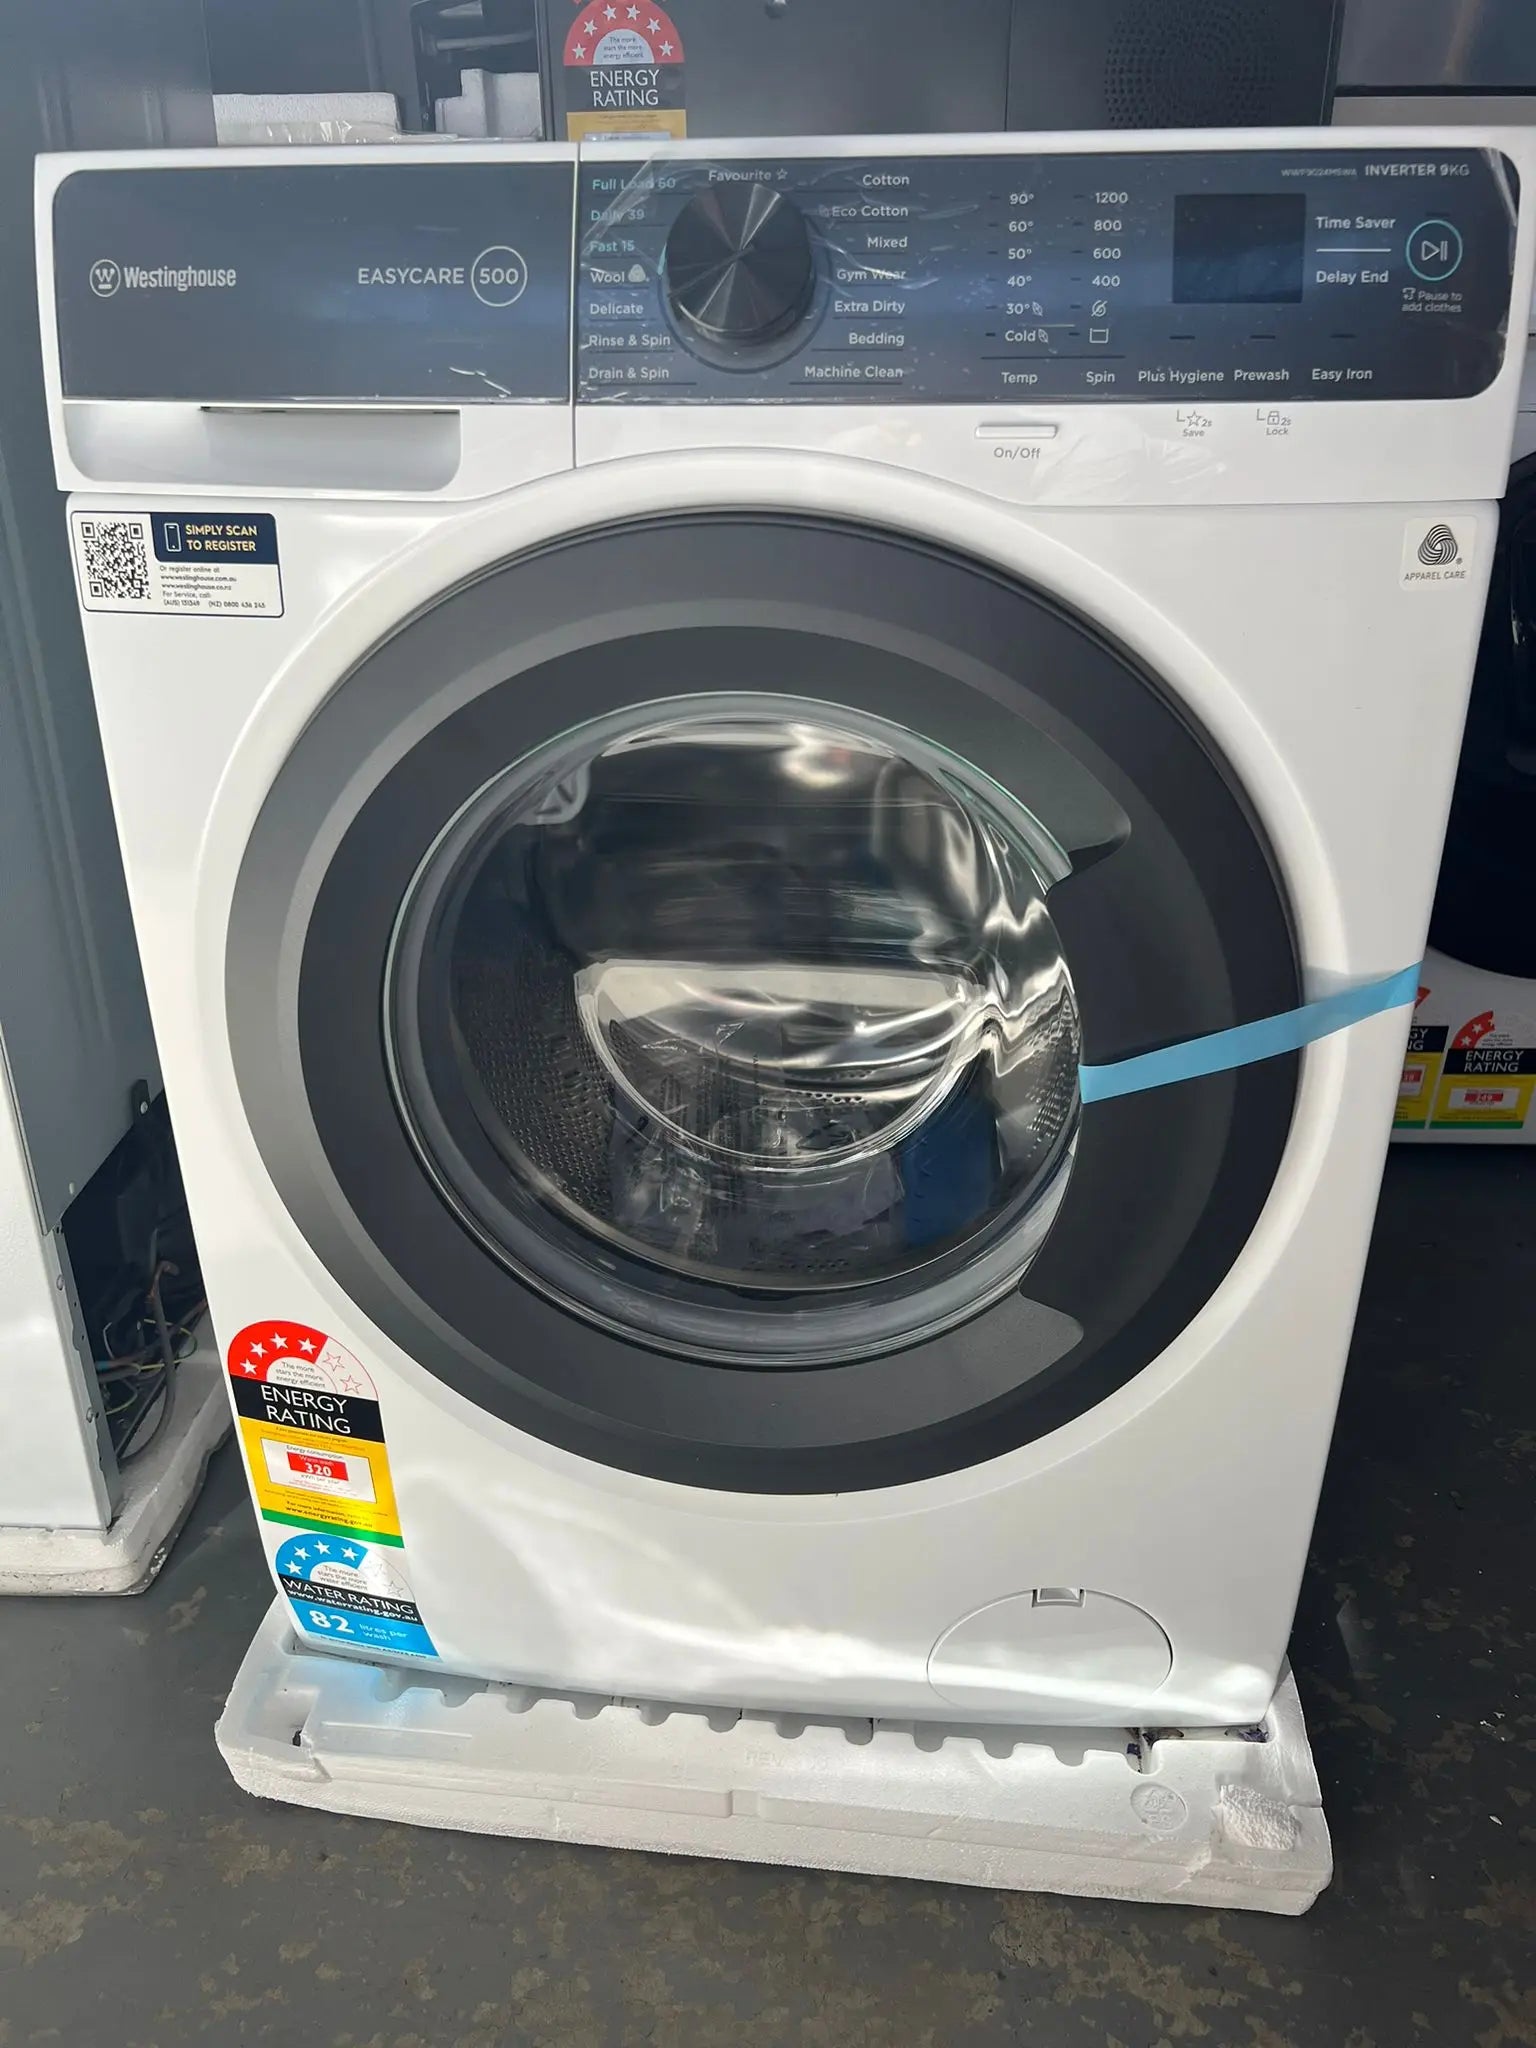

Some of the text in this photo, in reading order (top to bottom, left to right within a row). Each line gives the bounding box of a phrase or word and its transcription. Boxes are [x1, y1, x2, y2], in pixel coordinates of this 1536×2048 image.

[590, 69, 660, 87] ENERGY
[593, 89, 659, 107] RATING
[708, 169, 772, 182] Favourite
[1365, 164, 1436, 177] INVERTER
[1440, 163, 1470, 177] 9KG
[592, 178, 676, 190] Full Load 60
[862, 174, 910, 186] Cotton
[1095, 192, 1128, 204] 1200
[628, 209, 645, 221] 39
[832, 205, 909, 218] Eco Cotton
[1094, 220, 1122, 232] 800
[1316, 216, 1395, 230] Time Saver
[590, 241, 635, 252] Fast 15
[867, 236, 908, 249] Mixed
[1093, 248, 1121, 260] 600
[123, 266, 237, 291] Westinghouse
[357, 267, 519, 285] EASYCARE 500
[591, 271, 625, 283] Wool
[836, 268, 907, 283] Gym Wear
[1092, 276, 1120, 287] 400
[1316, 270, 1389, 285] Delay End
[1417, 291, 1463, 302] Pause to
[590, 302, 644, 315] Delicate
[834, 300, 906, 315] Extra Dirty
[1402, 301, 1463, 313] add clothes
[588, 335, 671, 349] Rinse & Spin
[849, 332, 905, 347] Bedding
[1005, 330, 1036, 343] Cold
[588, 367, 670, 382] Drain & Spin
[804, 365, 904, 379] Machine Clean
[1001, 372, 1038, 385] Temp
[1086, 371, 1116, 385] Spin
[1138, 371, 1225, 386] Plus Hygiene
[1233, 369, 1290, 381] Prewash
[1311, 368, 1373, 383] Easy Iron
[1202, 418, 1213, 428] 2s
[1280, 416, 1292, 427] 2s
[1182, 428, 1205, 438] Save
[1266, 426, 1289, 436] Lock
[993, 447, 1041, 460] On/Off
[185, 524, 258, 537] SIMPLY SCAN
[186, 539, 257, 552] TO REGISTER
[169, 566, 191, 574] register
[1404, 570, 1467, 581] APPAREL CARE
[173, 591, 198, 599] Service,
[1465, 1050, 1525, 1062] ENERGY
[1464, 1062, 1520, 1073] RATING
[282, 1361, 315, 1373] The more
[275, 1368, 291, 1376] stars
[305, 1373, 324, 1381] more
[276, 1375, 326, 1388] energy efficient
[261, 1384, 348, 1414] ENERGY
[266, 1404, 351, 1434] RATING
[286, 1445, 344, 1460] Energy consumption
[305, 1462, 332, 1477] 320
[317, 1570, 334, 1578] stars
[348, 1577, 368, 1585] more
[322, 1565, 359, 1578] The more
[283, 1578, 414, 1614] WATER RATING
[287, 1590, 418, 1622] www.waterrating.gov.au
[309, 1609, 355, 1634] 82
[363, 1631, 392, 1641] wash
[389, 1630, 409, 1638] per
